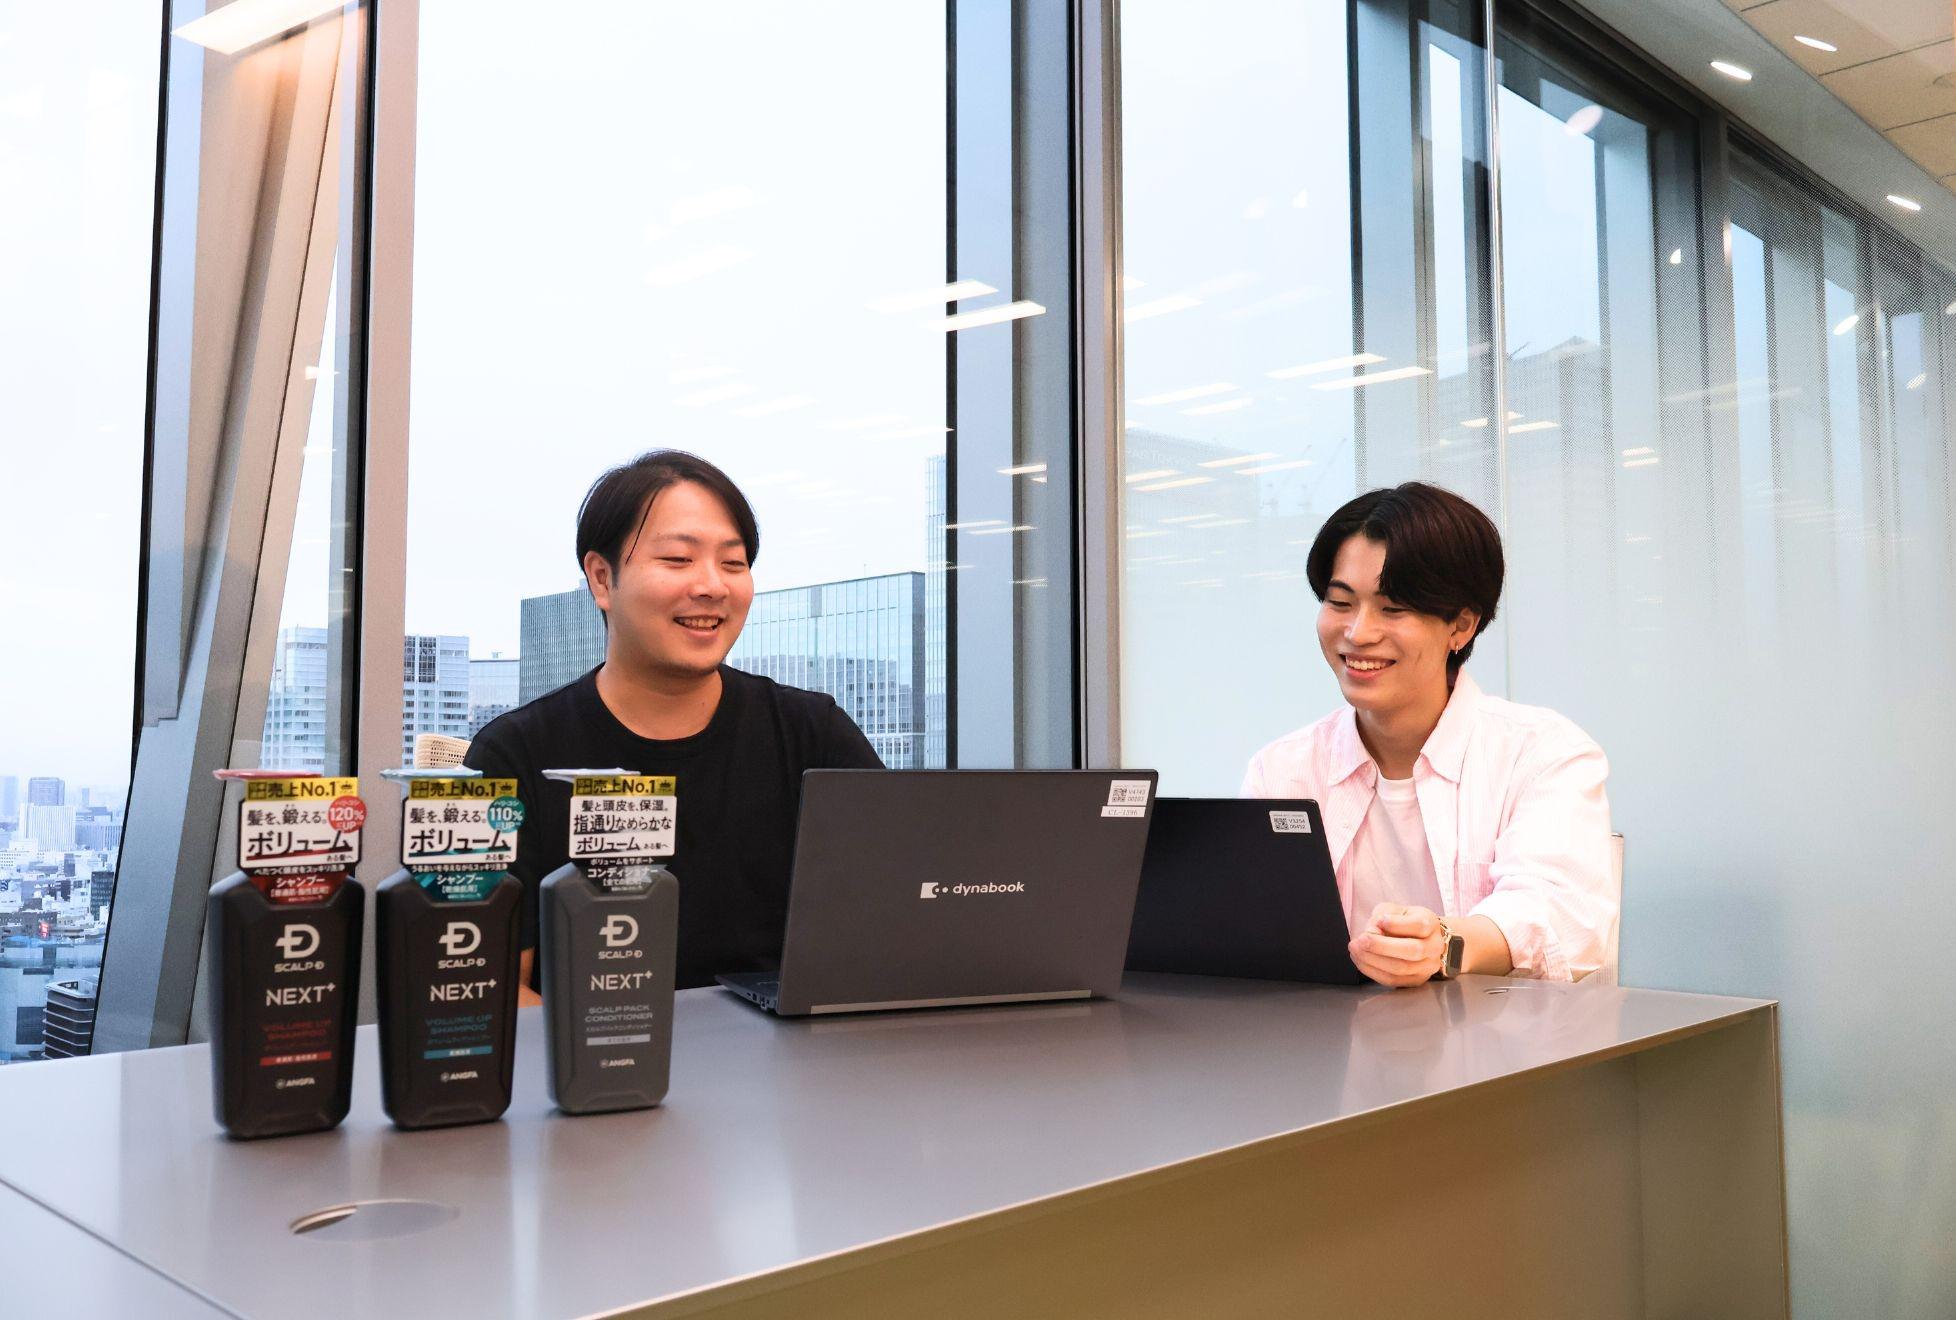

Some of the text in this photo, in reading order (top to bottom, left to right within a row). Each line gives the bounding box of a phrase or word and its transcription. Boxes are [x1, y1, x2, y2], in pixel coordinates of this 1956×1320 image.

[330, 807, 364, 821] 120%
[490, 807, 523, 821] 110%
[574, 814, 672, 832] 指通りなめらかな
[248, 830, 352, 857] ボリューム
[410, 829, 511, 853] ボリューム
[577, 836, 640, 853] ボリューム
[437, 873, 484, 885] シャンプー
[587, 866, 658, 878] コンディショナー
[276, 875, 325, 888] シャンプー
[952, 881, 1025, 897] dynabook
[588, 1004, 650, 1014] SCALP PACK
[585, 1012, 653, 1022] CONDITIONER
